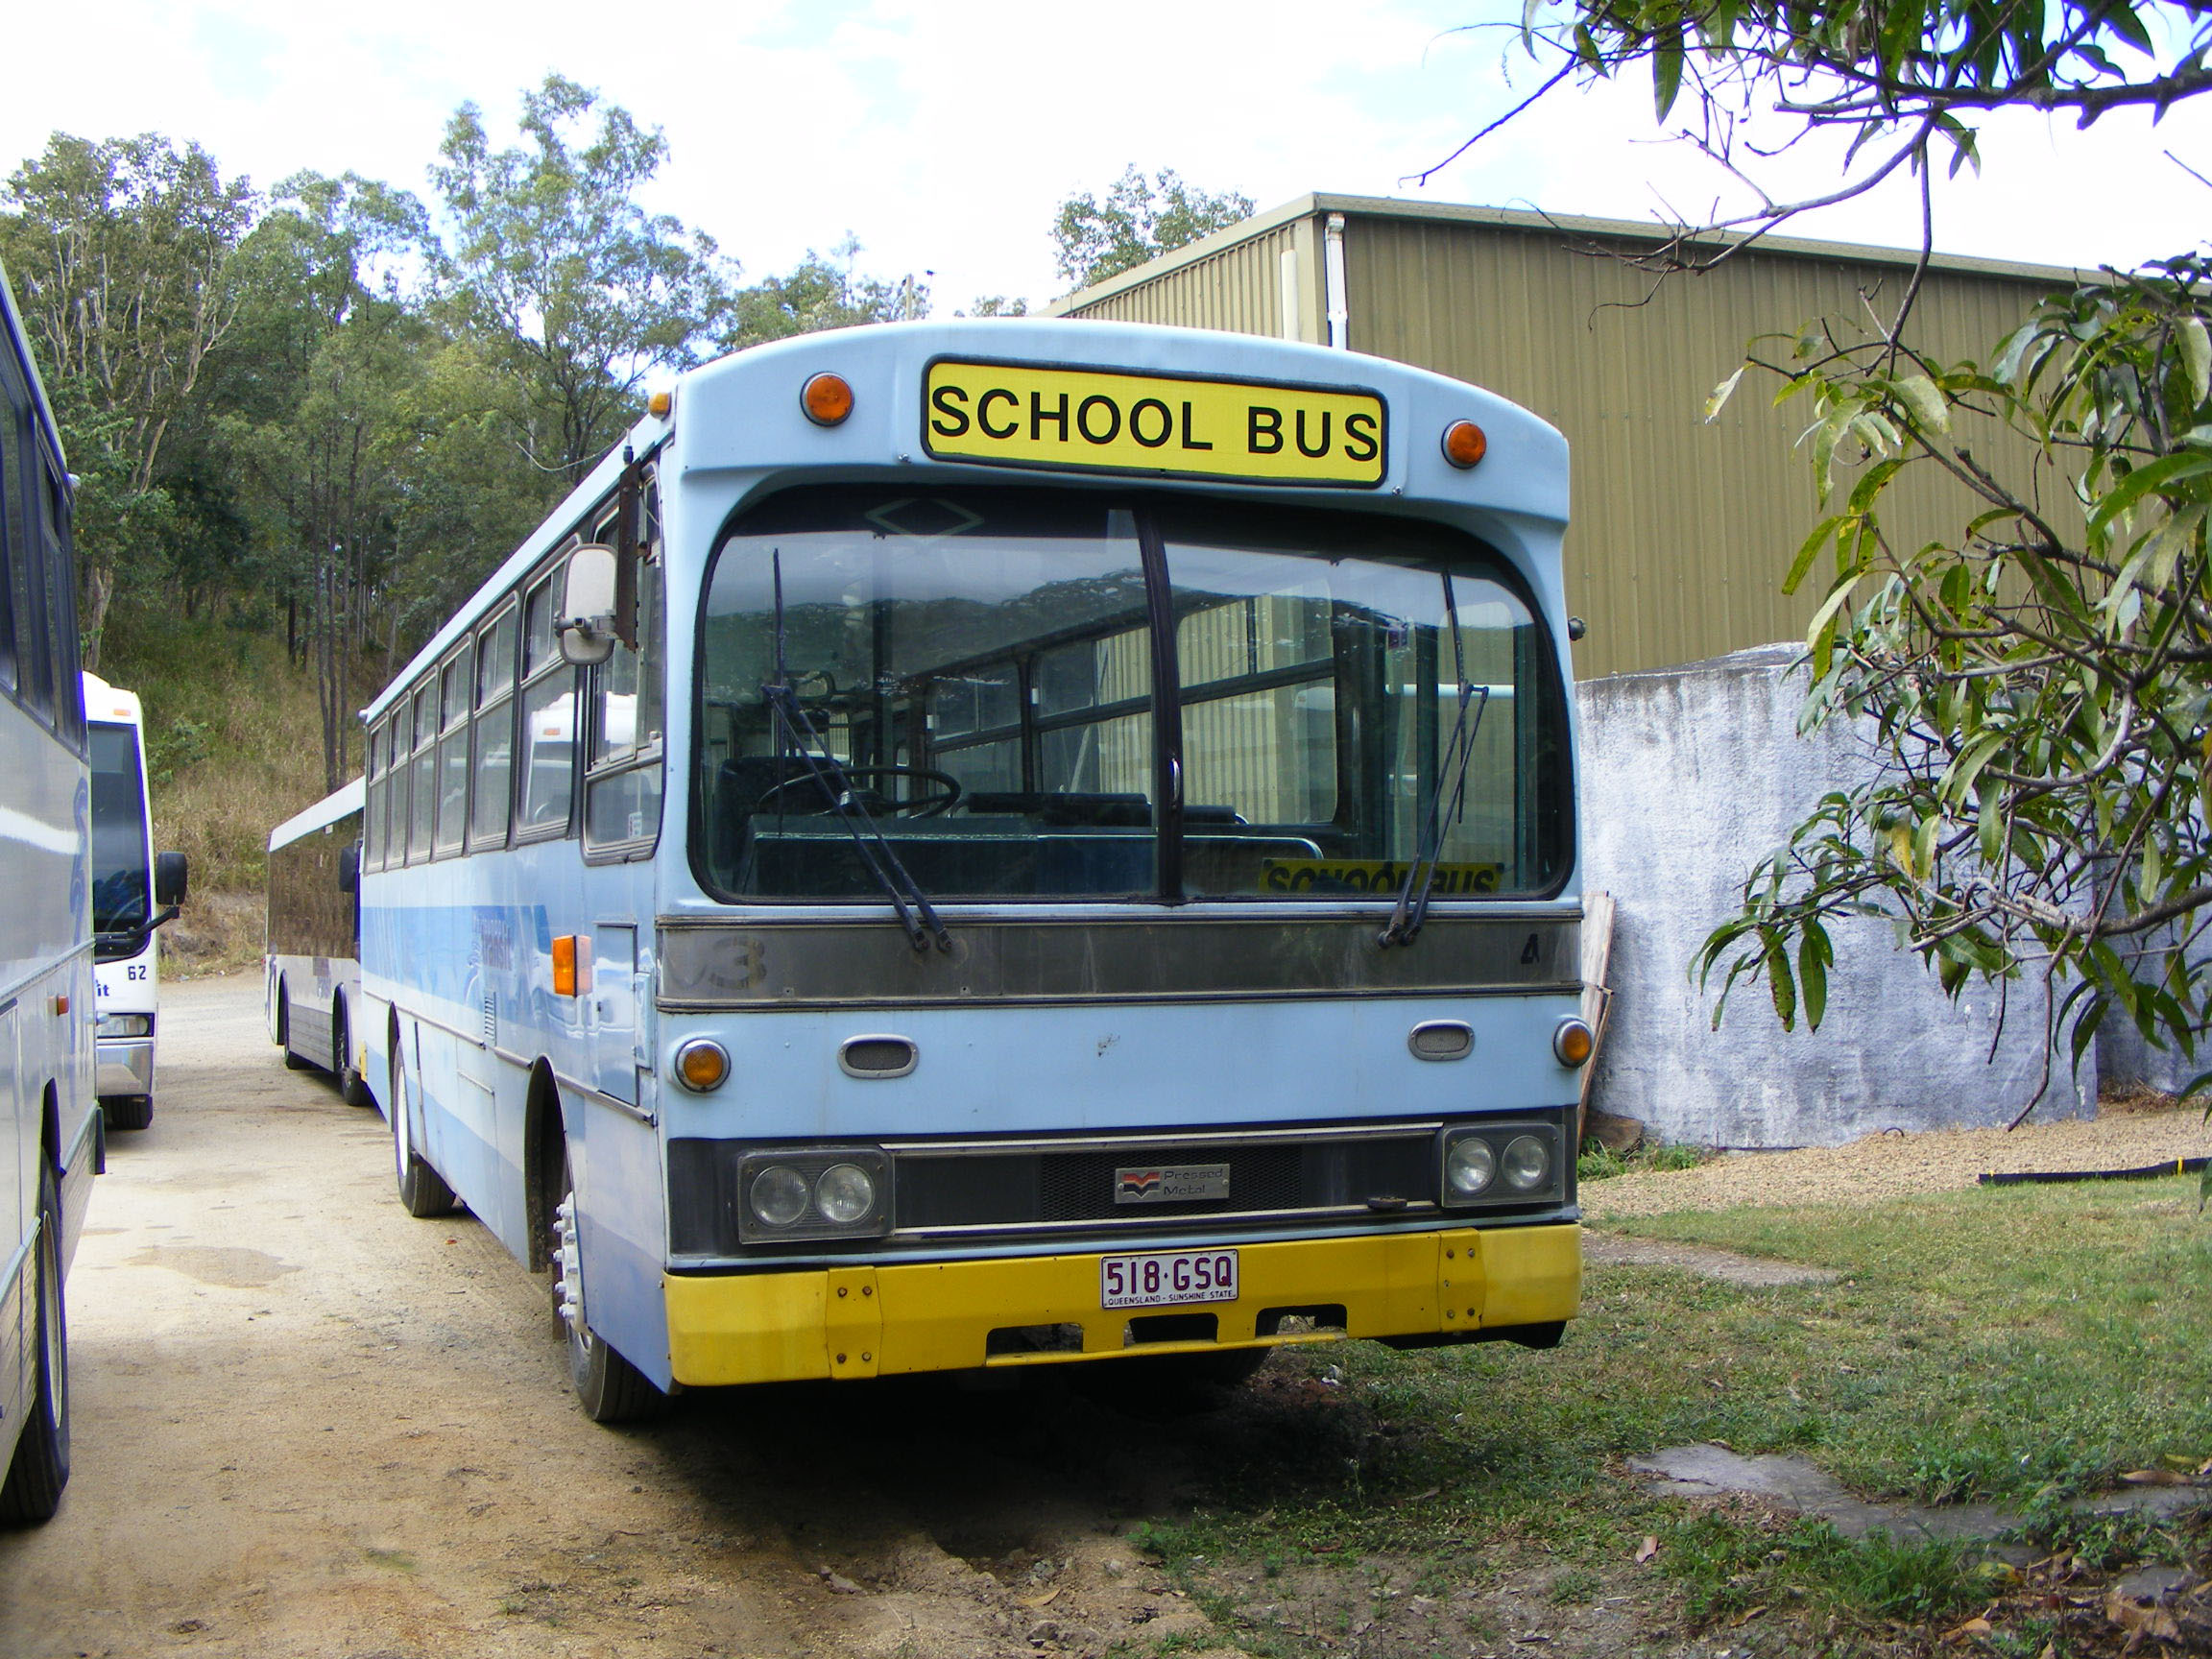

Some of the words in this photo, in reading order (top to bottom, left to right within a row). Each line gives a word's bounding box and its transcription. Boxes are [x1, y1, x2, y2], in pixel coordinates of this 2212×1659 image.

[931, 386, 1213, 450] SCHOOL
[1248, 406, 1378, 461] BUS
[128, 965, 146, 980] 62
[1165, 1168, 1223, 1180] Pressed
[1164, 1184, 1205, 1196] Metal
[1108, 1294, 1161, 1306] QUEENSLAND
[1168, 1291, 1206, 1302] SUNSHINE
[1210, 1289, 1233, 1299] STATE
